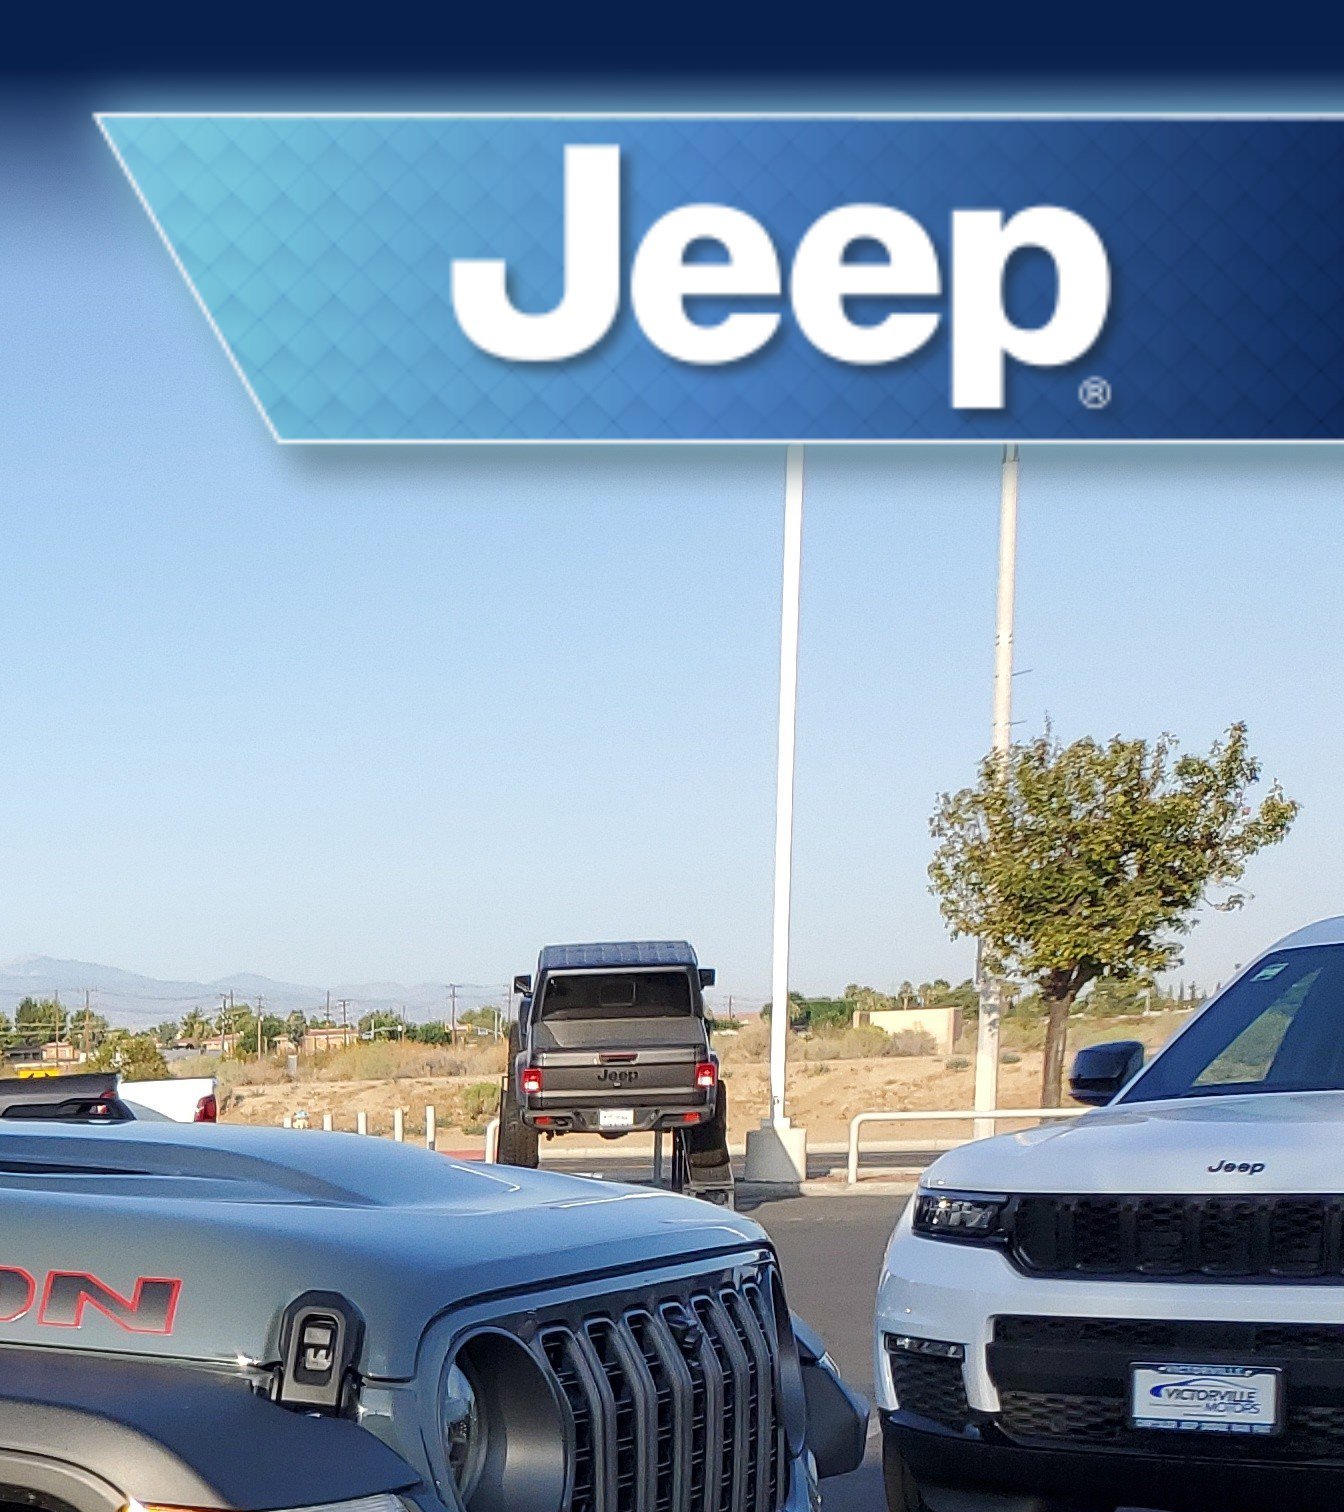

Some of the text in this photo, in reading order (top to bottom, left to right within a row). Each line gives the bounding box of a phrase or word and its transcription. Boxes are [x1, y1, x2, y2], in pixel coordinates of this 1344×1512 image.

[597, 1069, 639, 1083] Jeep
[1208, 1159, 1266, 1176] Jeep
[1165, 1388, 1257, 1403] VICTORVILLE
